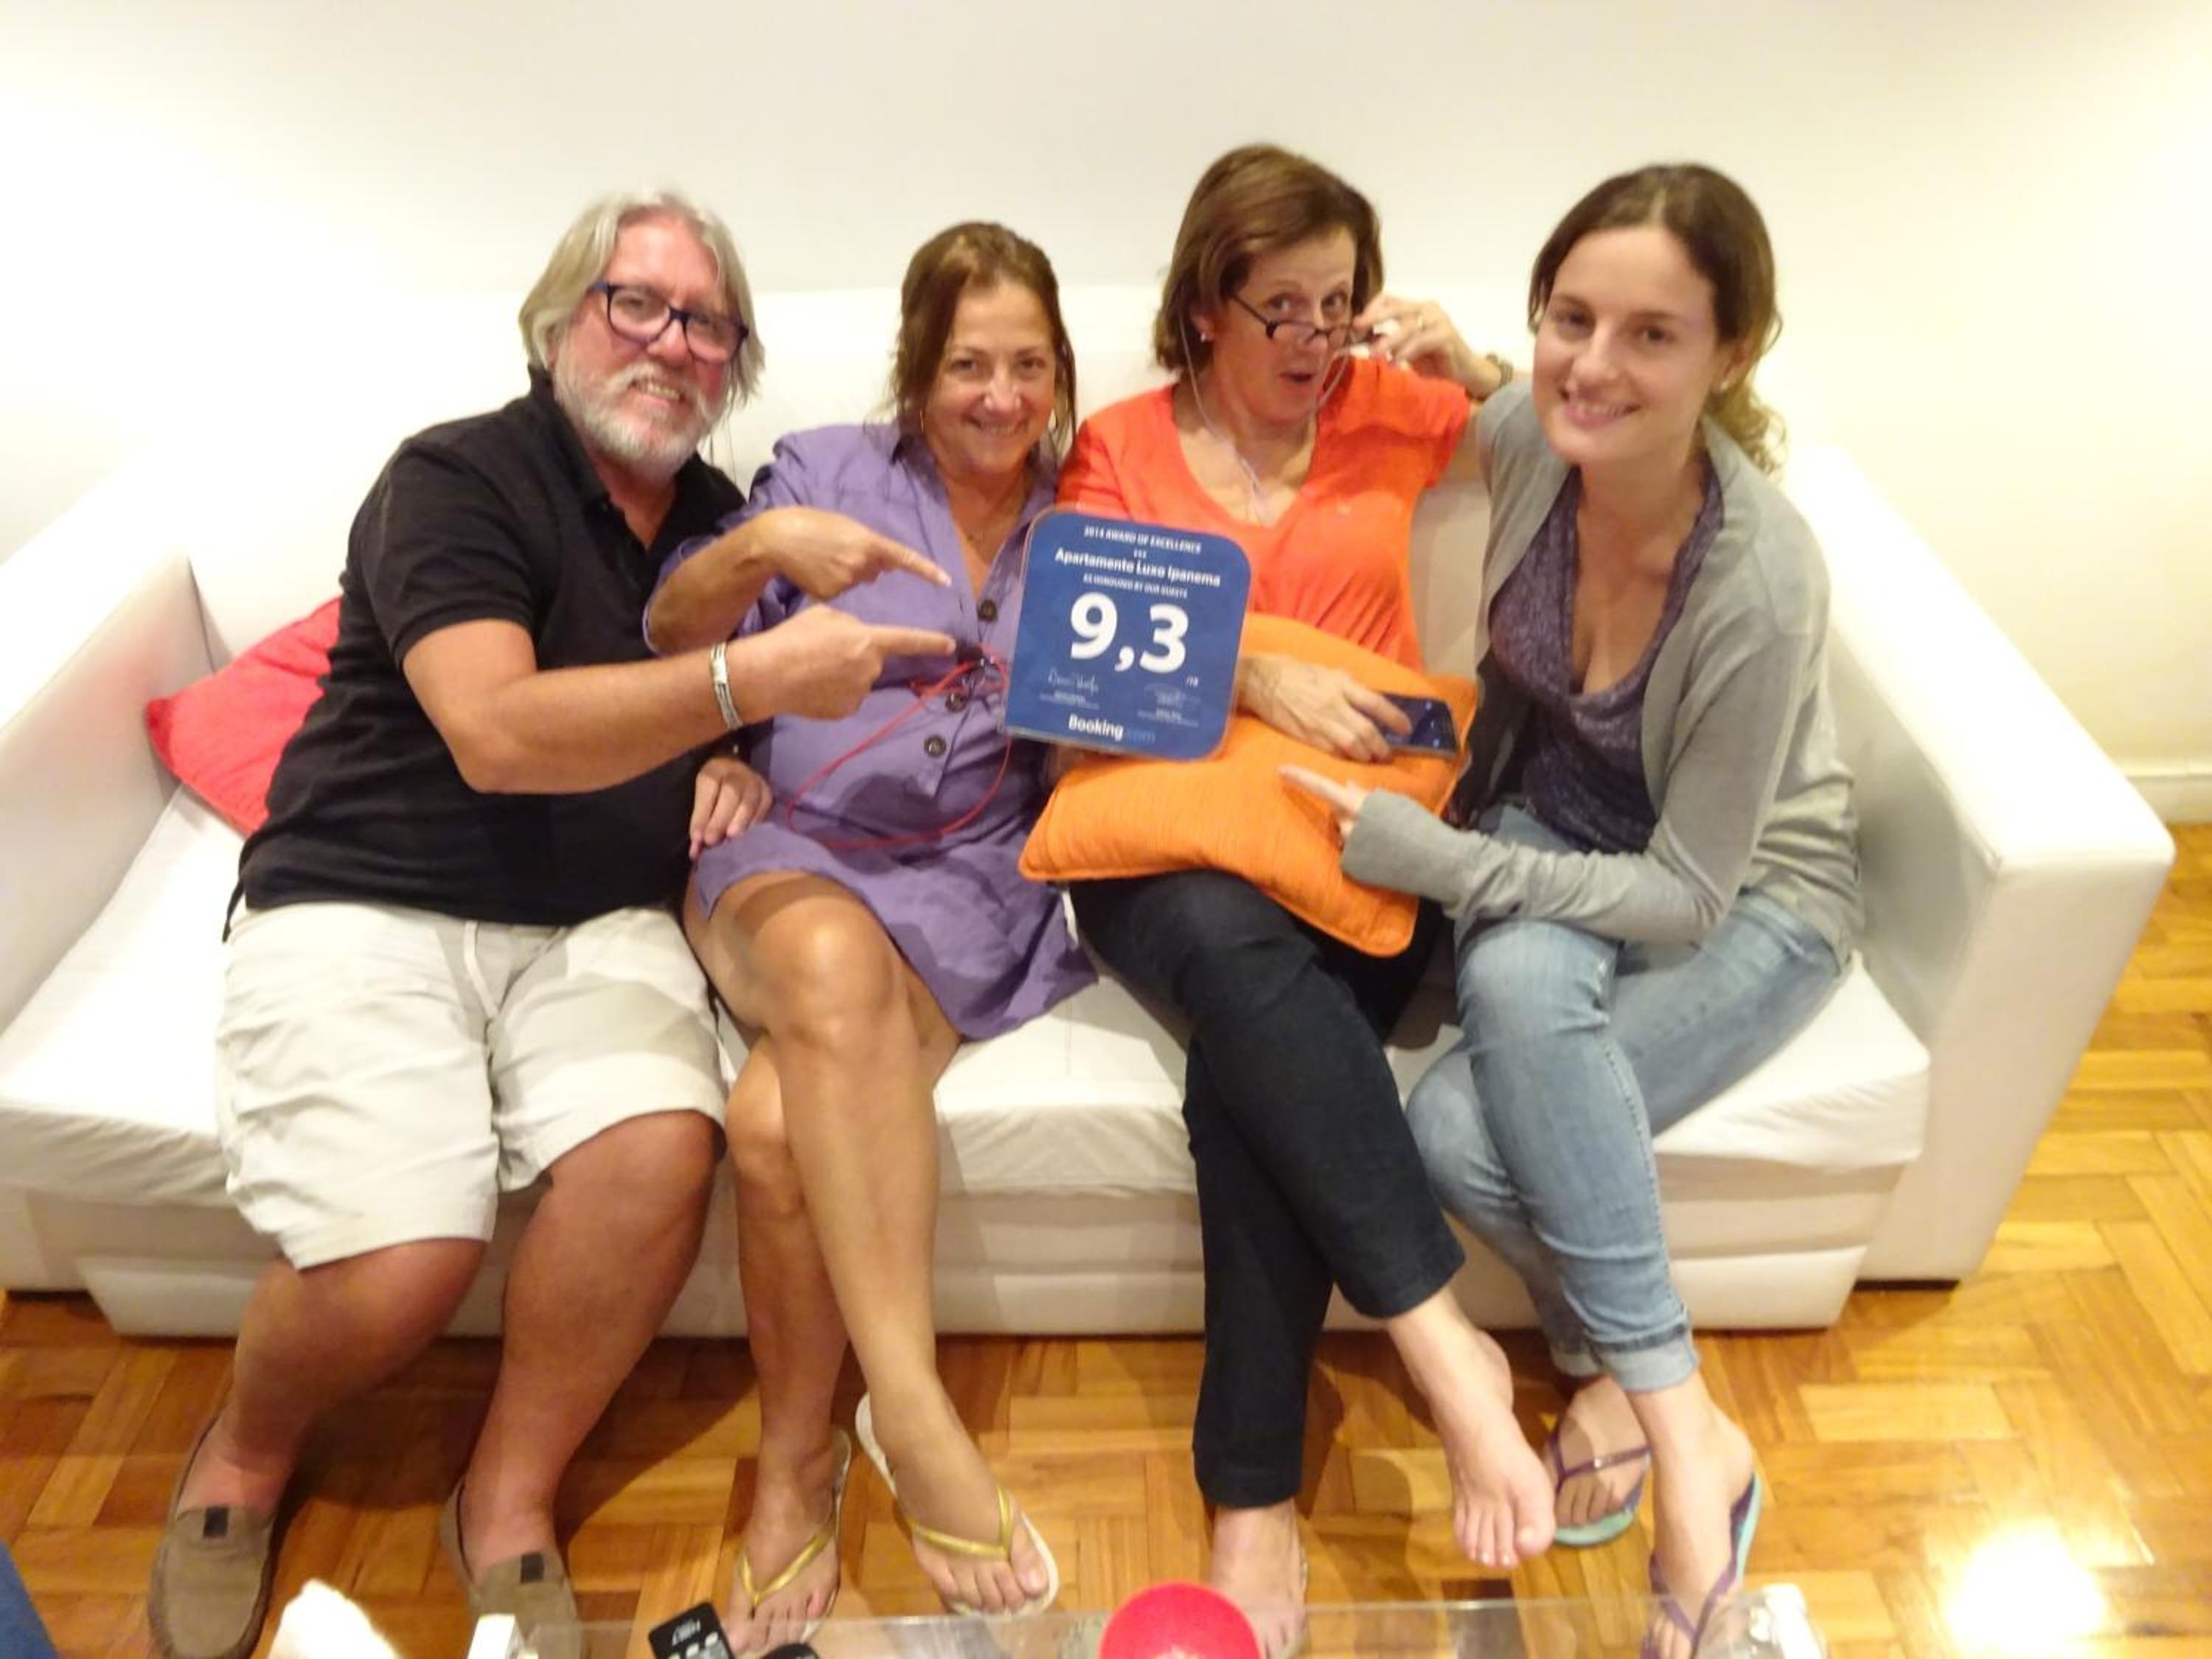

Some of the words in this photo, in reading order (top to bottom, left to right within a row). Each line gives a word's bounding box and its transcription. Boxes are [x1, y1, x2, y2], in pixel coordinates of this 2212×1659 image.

[1105, 529, 1136, 543] AWARD
[1137, 533, 1149, 546] OF
[1150, 535, 1201, 554] EXCELLENCE
[1167, 566, 1220, 587] Ipanema
[1071, 592, 1189, 672] 9,3
